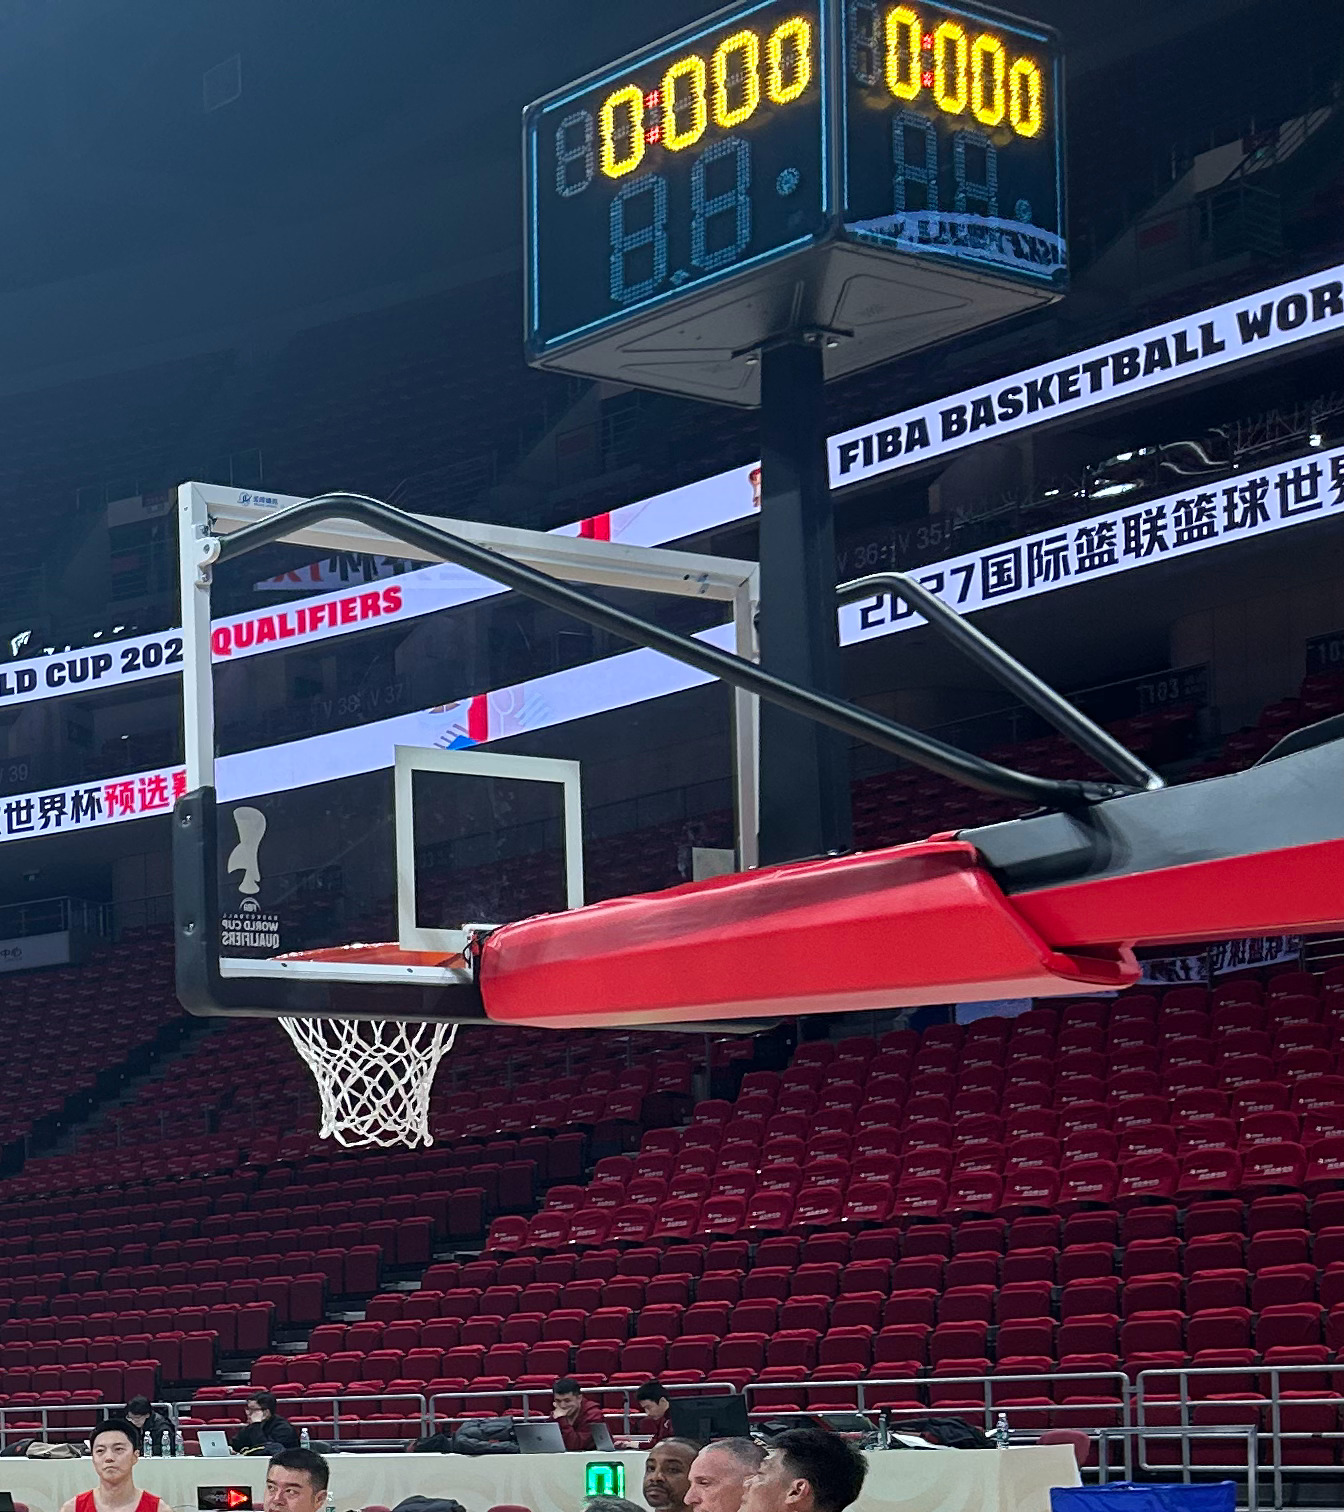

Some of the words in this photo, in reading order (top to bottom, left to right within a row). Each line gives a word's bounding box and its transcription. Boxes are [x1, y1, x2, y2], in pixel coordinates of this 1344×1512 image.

[838, 418, 931, 474] FIBA
[940, 321, 1225, 440] BASKETBALL
[1236, 280, 1344, 345] WOR
[860, 455, 1344, 630] 27国际篮联篮球世
[45, 652, 113, 687] CUP
[120, 638, 184, 674] 202
[212, 586, 402, 656] QUALIFIERS
[1319, 640, 1344, 664] 10
[9, 764, 28, 782] 39
